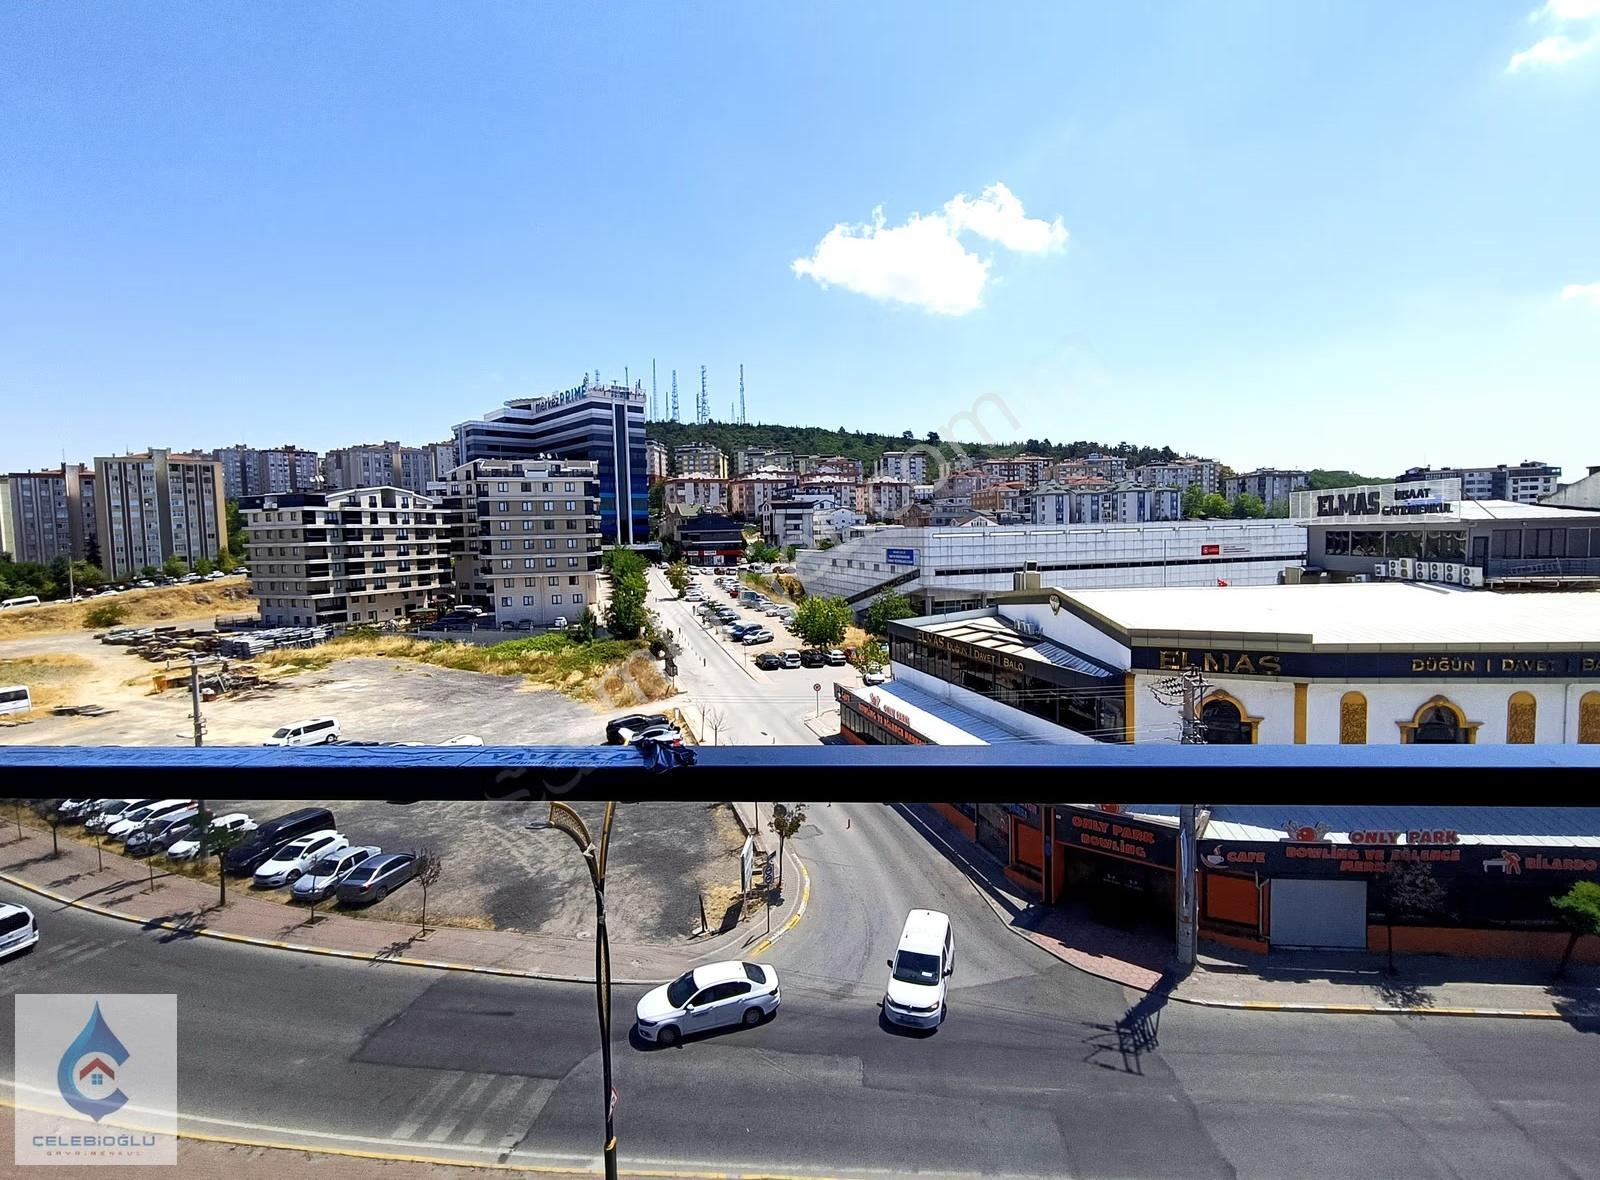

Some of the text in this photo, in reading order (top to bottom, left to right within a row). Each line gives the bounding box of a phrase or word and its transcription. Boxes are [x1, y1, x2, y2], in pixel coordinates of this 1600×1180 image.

[559, 384, 587, 406] PRIME
[1317, 491, 1381, 516] ELMAS
[1003, 656, 1024, 672] BALO
[1159, 650, 1281, 675] ELMAS
[1412, 656, 1475, 672] DÜĞÜN
[1072, 815, 1155, 844] ONLY PARK
[1350, 830, 1460, 844] ONLY PARK
[1227, 851, 1266, 863] CAFE
[1365, 849, 1385, 860] VE
